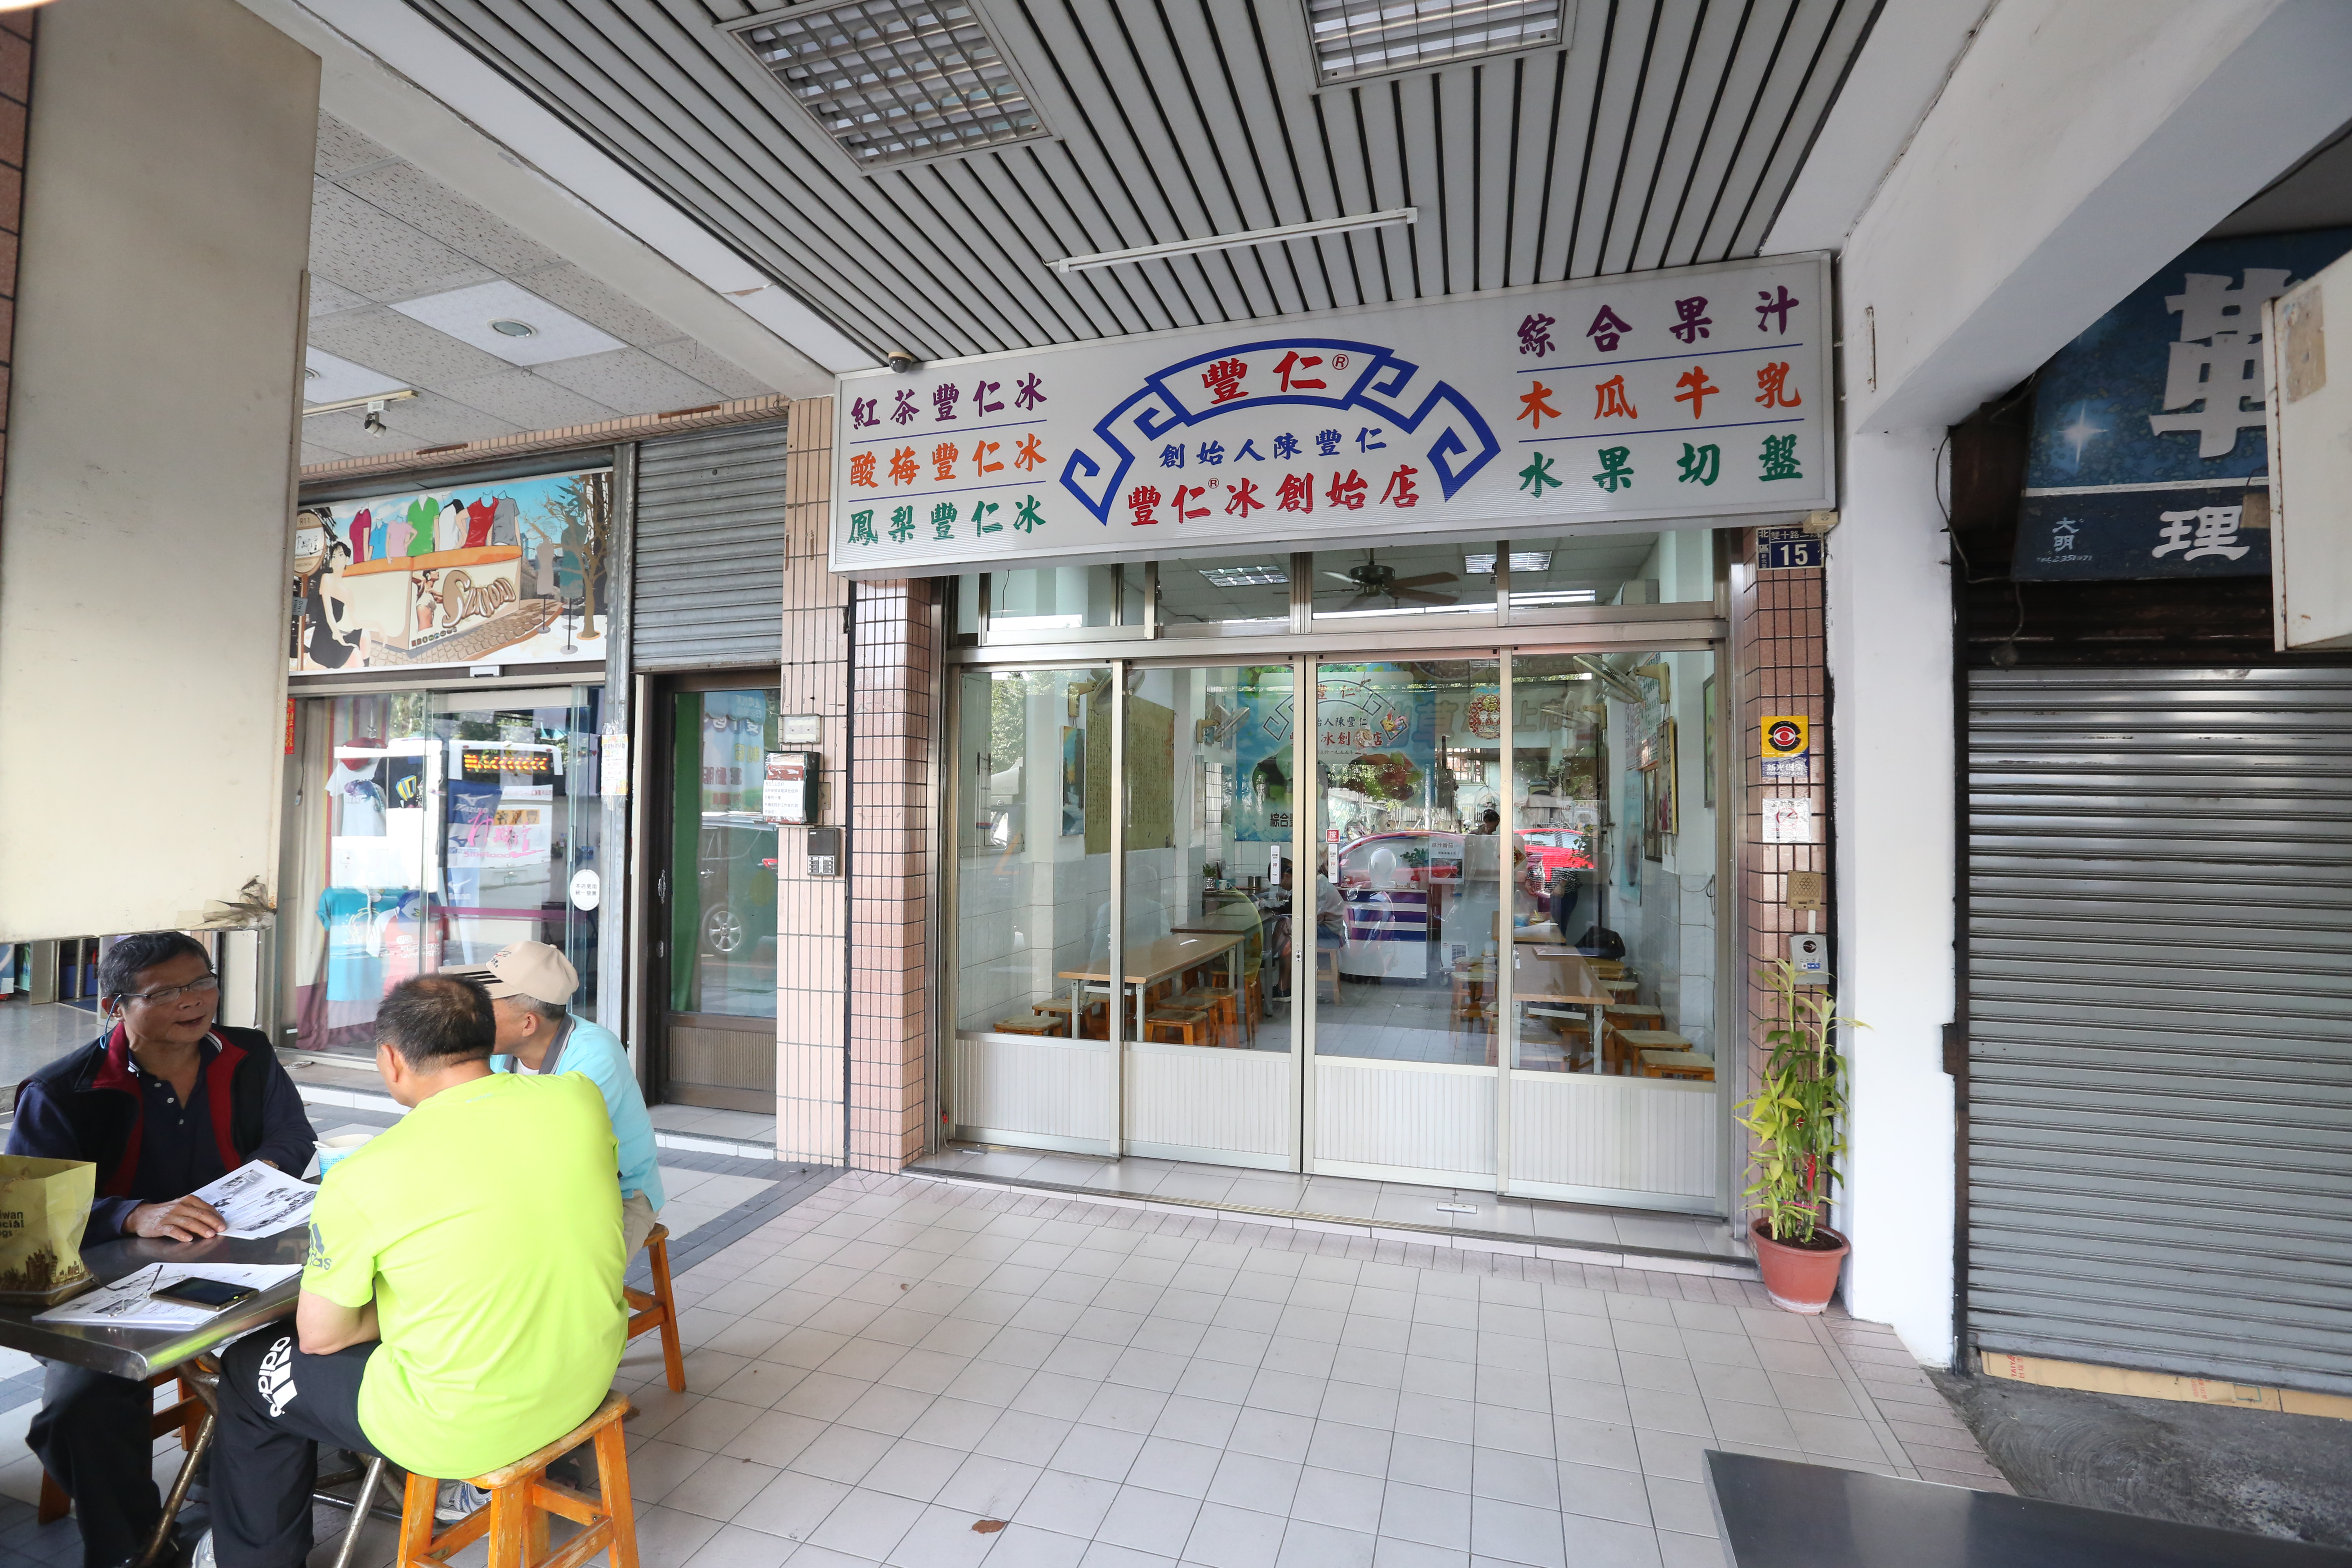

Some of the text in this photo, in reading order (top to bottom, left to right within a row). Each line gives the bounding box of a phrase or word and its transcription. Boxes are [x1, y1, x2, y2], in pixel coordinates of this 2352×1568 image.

[1517, 285, 1799, 358] 綜合果汁
[851, 372, 1048, 430] 紅茶豐仁冰
[1517, 362, 1802, 430] 木瓜牛乳
[850, 433, 1047, 488] 酸梅豐仁冰
[1160, 427, 1387, 468] 創始人陳豐仁
[1519, 434, 1803, 498] 水果切盤
[848, 494, 1046, 546] 鳳梨豐仁冰
[2052, 517, 2080, 552] 大明
[2152, 505, 2250, 561] 理
[1780, 543, 1808, 565] 15
